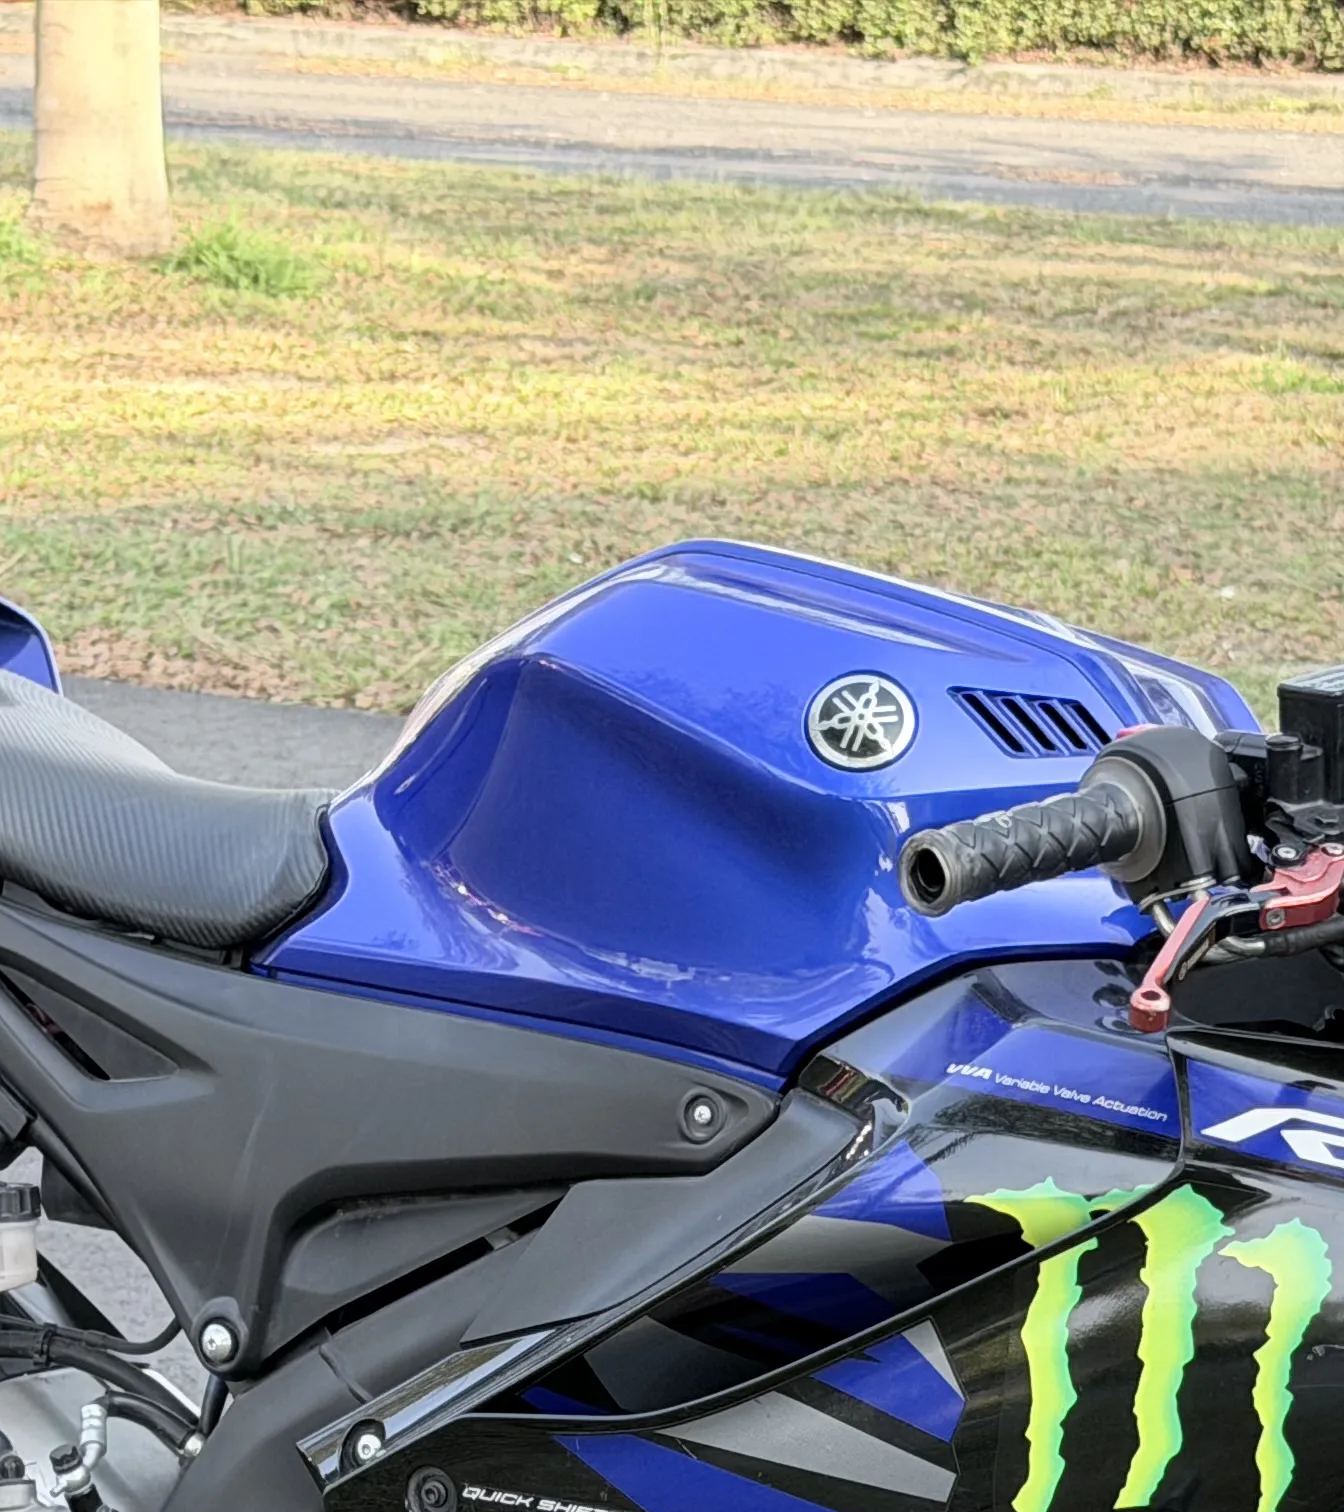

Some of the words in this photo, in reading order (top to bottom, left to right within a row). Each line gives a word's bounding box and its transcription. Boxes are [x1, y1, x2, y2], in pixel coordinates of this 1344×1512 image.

[947, 1063, 993, 1080] VVA
[994, 1072, 1051, 1094] Variable
[1053, 1084, 1091, 1104] Valve
[1092, 1095, 1168, 1122] Actuation
[462, 1486, 534, 1508] QUICK
